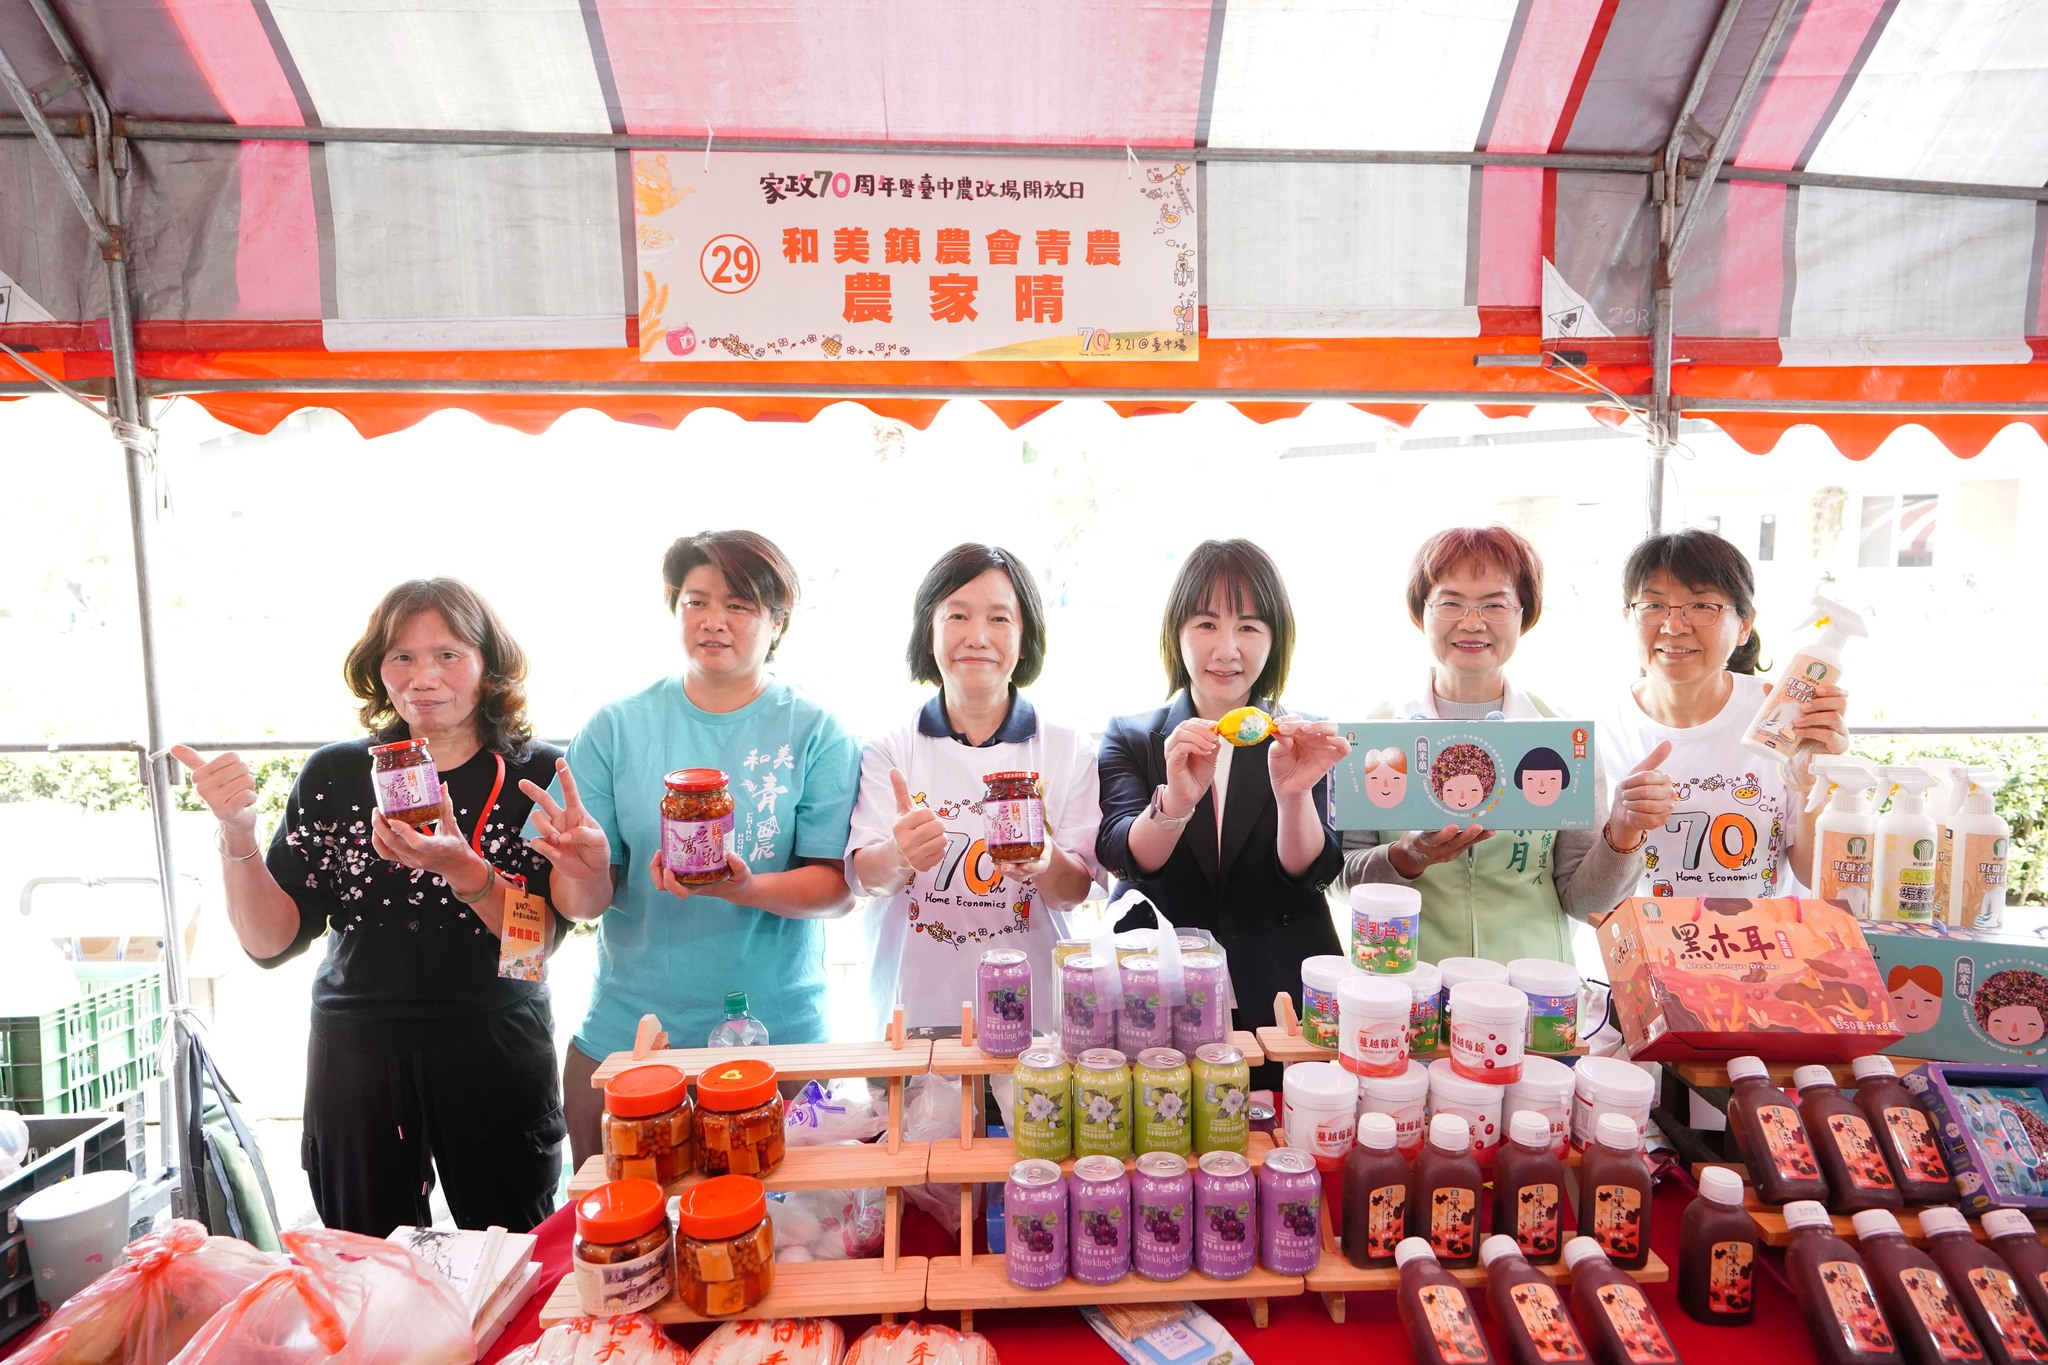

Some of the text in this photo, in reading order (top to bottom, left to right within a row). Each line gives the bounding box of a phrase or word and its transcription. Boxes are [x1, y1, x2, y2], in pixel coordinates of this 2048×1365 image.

[759, 170, 1085, 204] 家政70周年暨臺中農改場開放日
[782, 228, 1122, 267] 和美鎮農會青農
[711, 244, 754, 285] 29
[842, 272, 1065, 324] 農家晴
[743, 744, 795, 771] 和美
[1532, 830, 1552, 885] 候選人
[1676, 871, 1757, 882] Home Economics
[925, 893, 1006, 908] Home Economics
[1356, 921, 1399, 942] 羊乳片
[1671, 923, 1775, 961] 黑木耳
[1750, 963, 1780, 971] Drinks
[1958, 963, 1971, 995] 脆米菓
[1359, 1036, 1399, 1049] 蔓越莓錠
[1076, 1255, 1111, 1269] Sparkling
[1136, 1249, 1189, 1267] Sparkling Mead
[1201, 1249, 1237, 1265] Sparkling
[1273, 1246, 1309, 1260] Sparkling
[1010, 1259, 1064, 1276] Sparkling Mead
